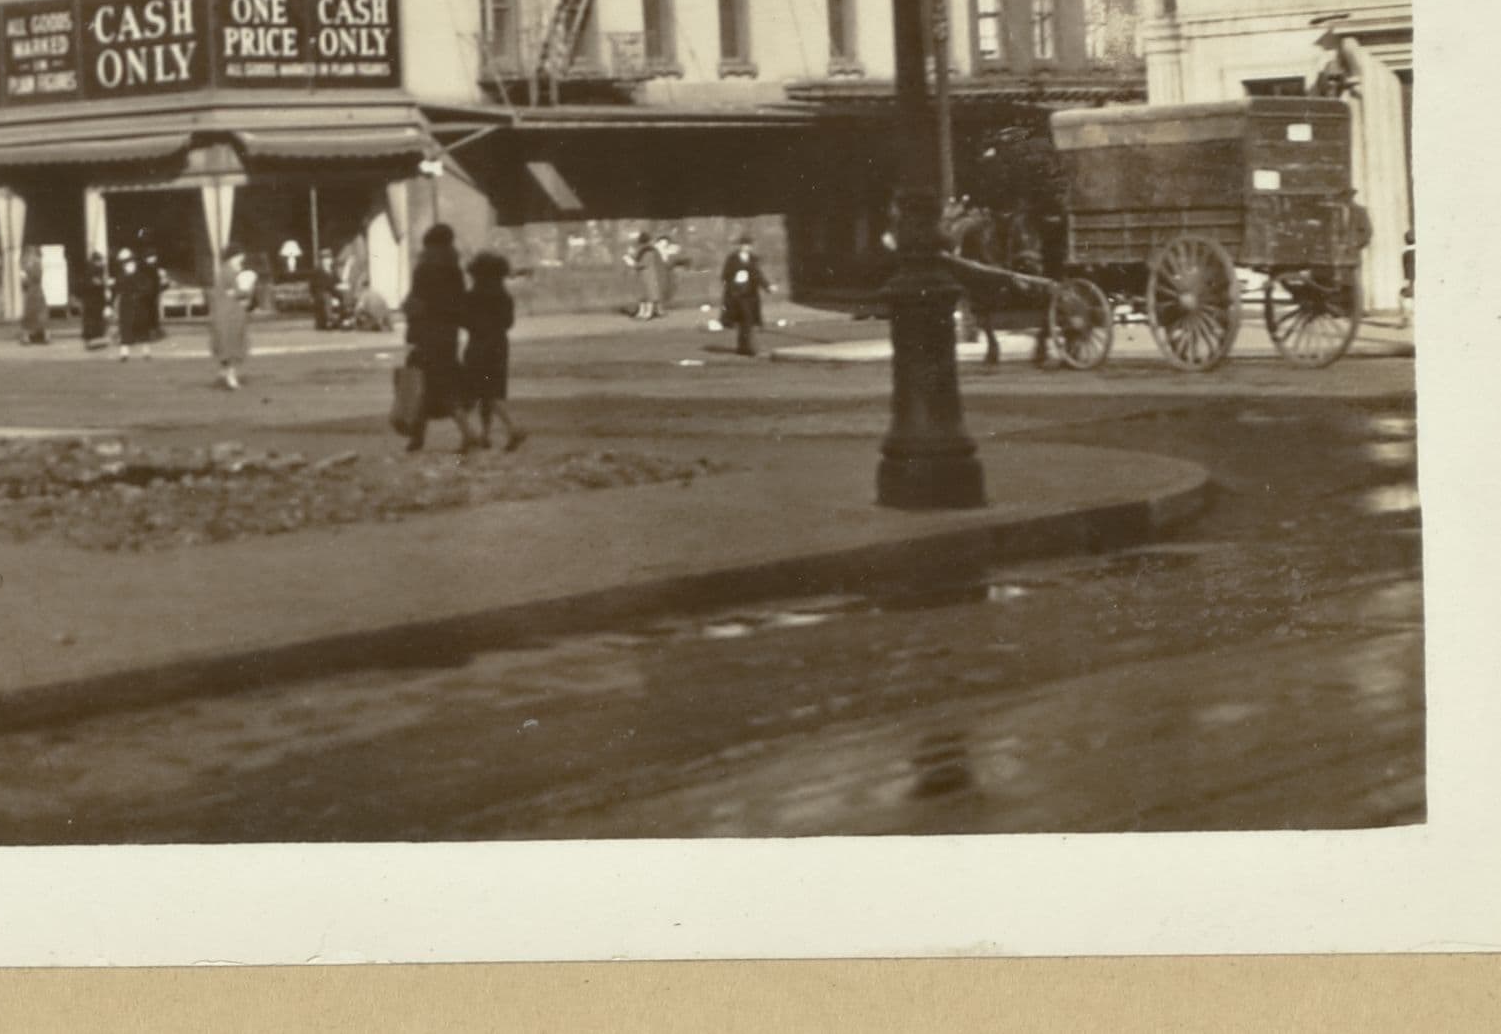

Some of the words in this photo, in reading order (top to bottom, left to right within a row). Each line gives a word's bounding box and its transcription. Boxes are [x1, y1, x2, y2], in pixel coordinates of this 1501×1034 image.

[223, 27, 299, 58] PRICE
[318, 27, 391, 58] ONLY
[97, 41, 197, 89] ONLY
